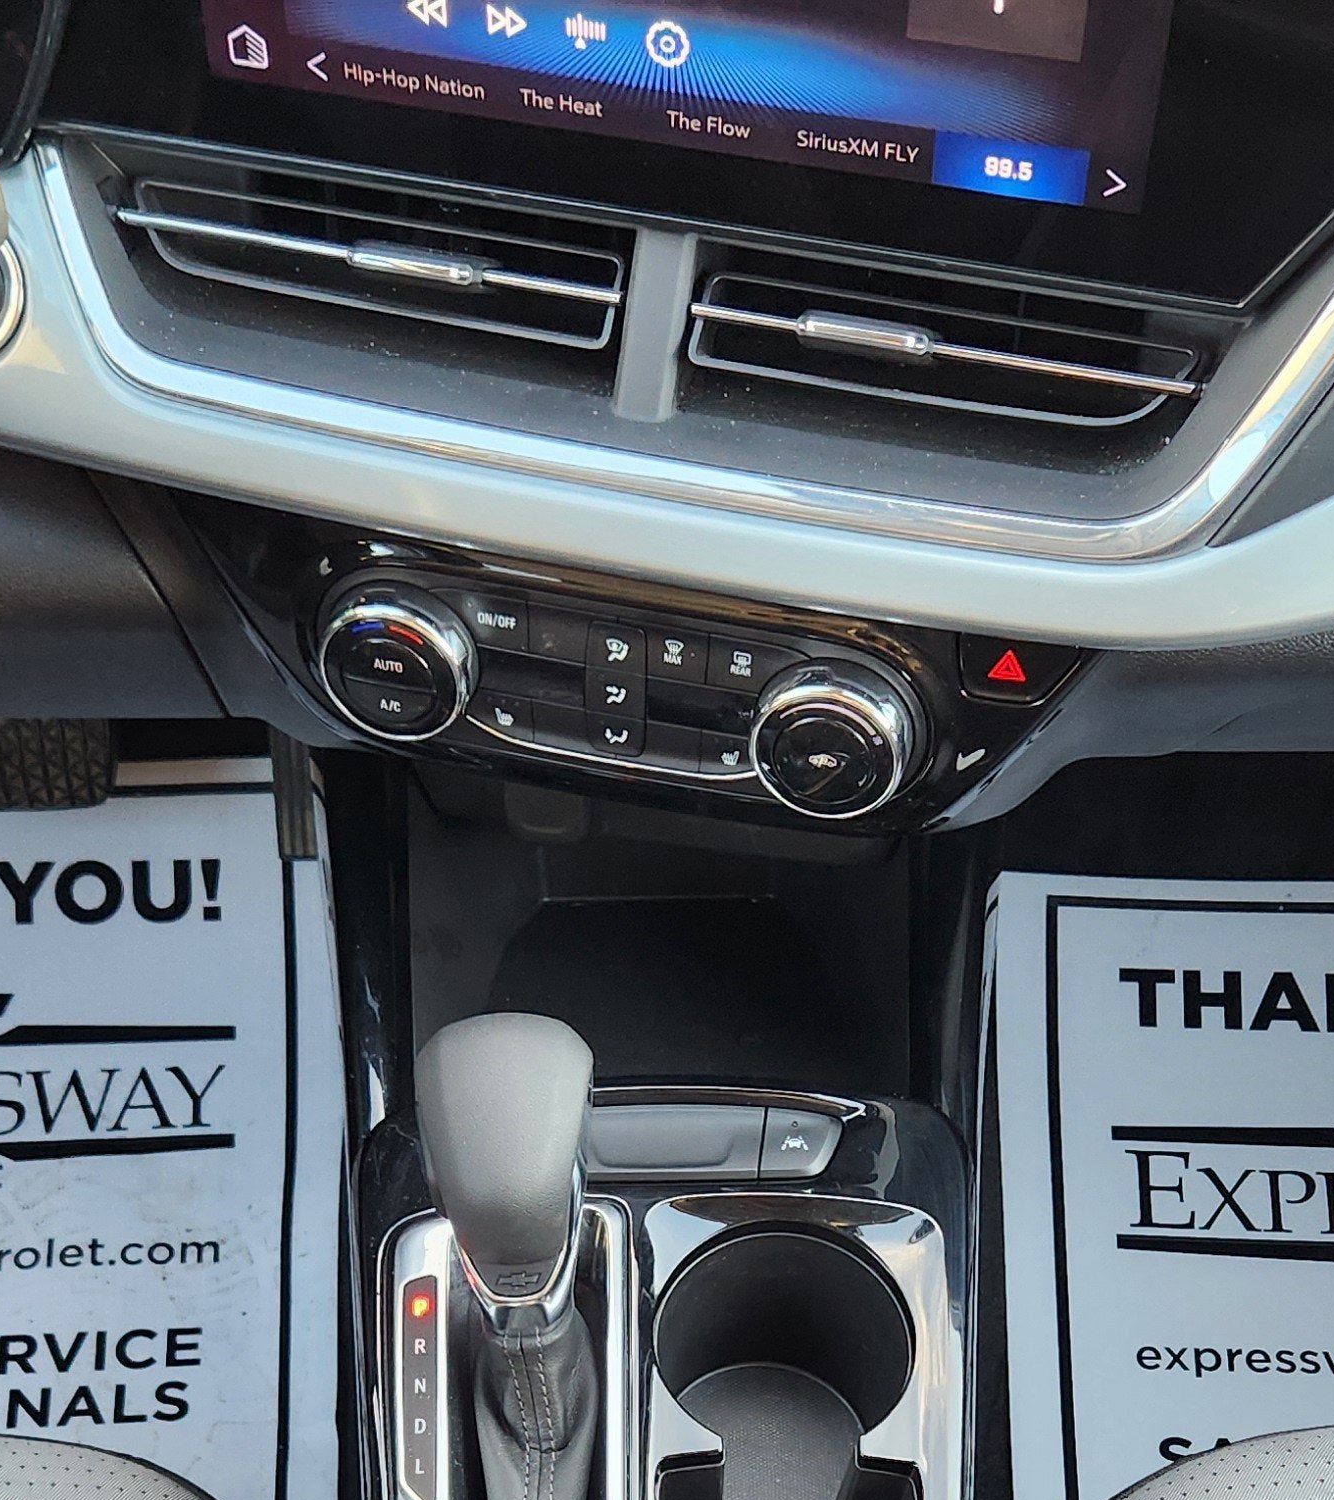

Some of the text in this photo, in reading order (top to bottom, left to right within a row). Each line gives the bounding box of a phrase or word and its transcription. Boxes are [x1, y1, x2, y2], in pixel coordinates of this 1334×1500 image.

[343, 61, 485, 100] Hip-Hop Nation
[518, 87, 603, 118] The Heat
[667, 109, 751, 140] The Flow
[796, 129, 920, 164] SiriusXM FLY
[983, 155, 1034, 182] 99.5
[477, 612, 517, 630] ON/OFF
[373, 658, 404, 673] AUTO
[663, 653, 683, 666] MAX
[730, 664, 752, 677] REAR
[380, 698, 402, 713] A/C
[412, 1297, 428, 1316] P
[414, 1338, 427, 1355] R
[414, 1378, 427, 1394] N
[414, 1418, 427, 1435] D
[414, 1458, 425, 1475] L
